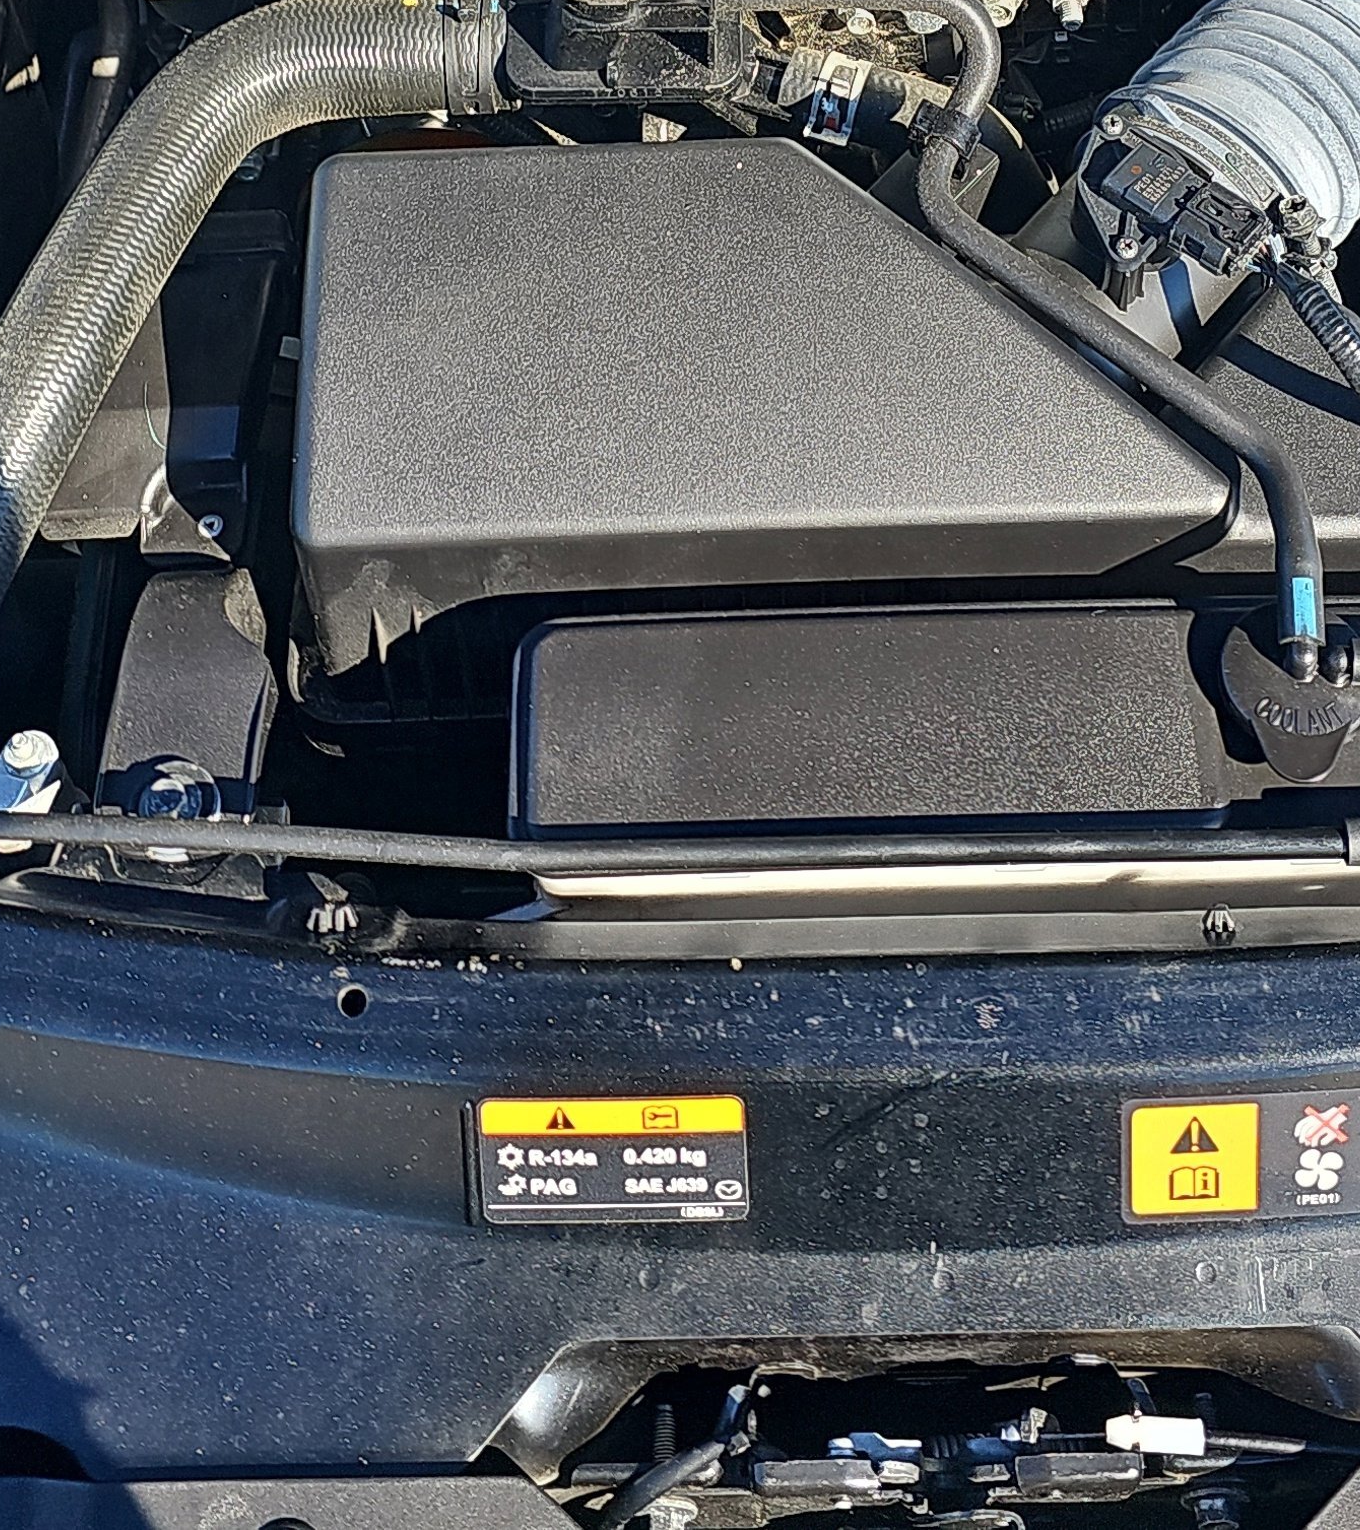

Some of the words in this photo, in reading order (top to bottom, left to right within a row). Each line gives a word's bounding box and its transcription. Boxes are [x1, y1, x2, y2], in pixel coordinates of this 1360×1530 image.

[1254, 696, 1344, 736] COOLANT
[528, 1148, 598, 1167] R-134a
[623, 1147, 677, 1166] 0.420
[680, 1147, 707, 1168] kg
[530, 1179, 578, 1196] PAG
[625, 1177, 665, 1194] SAE
